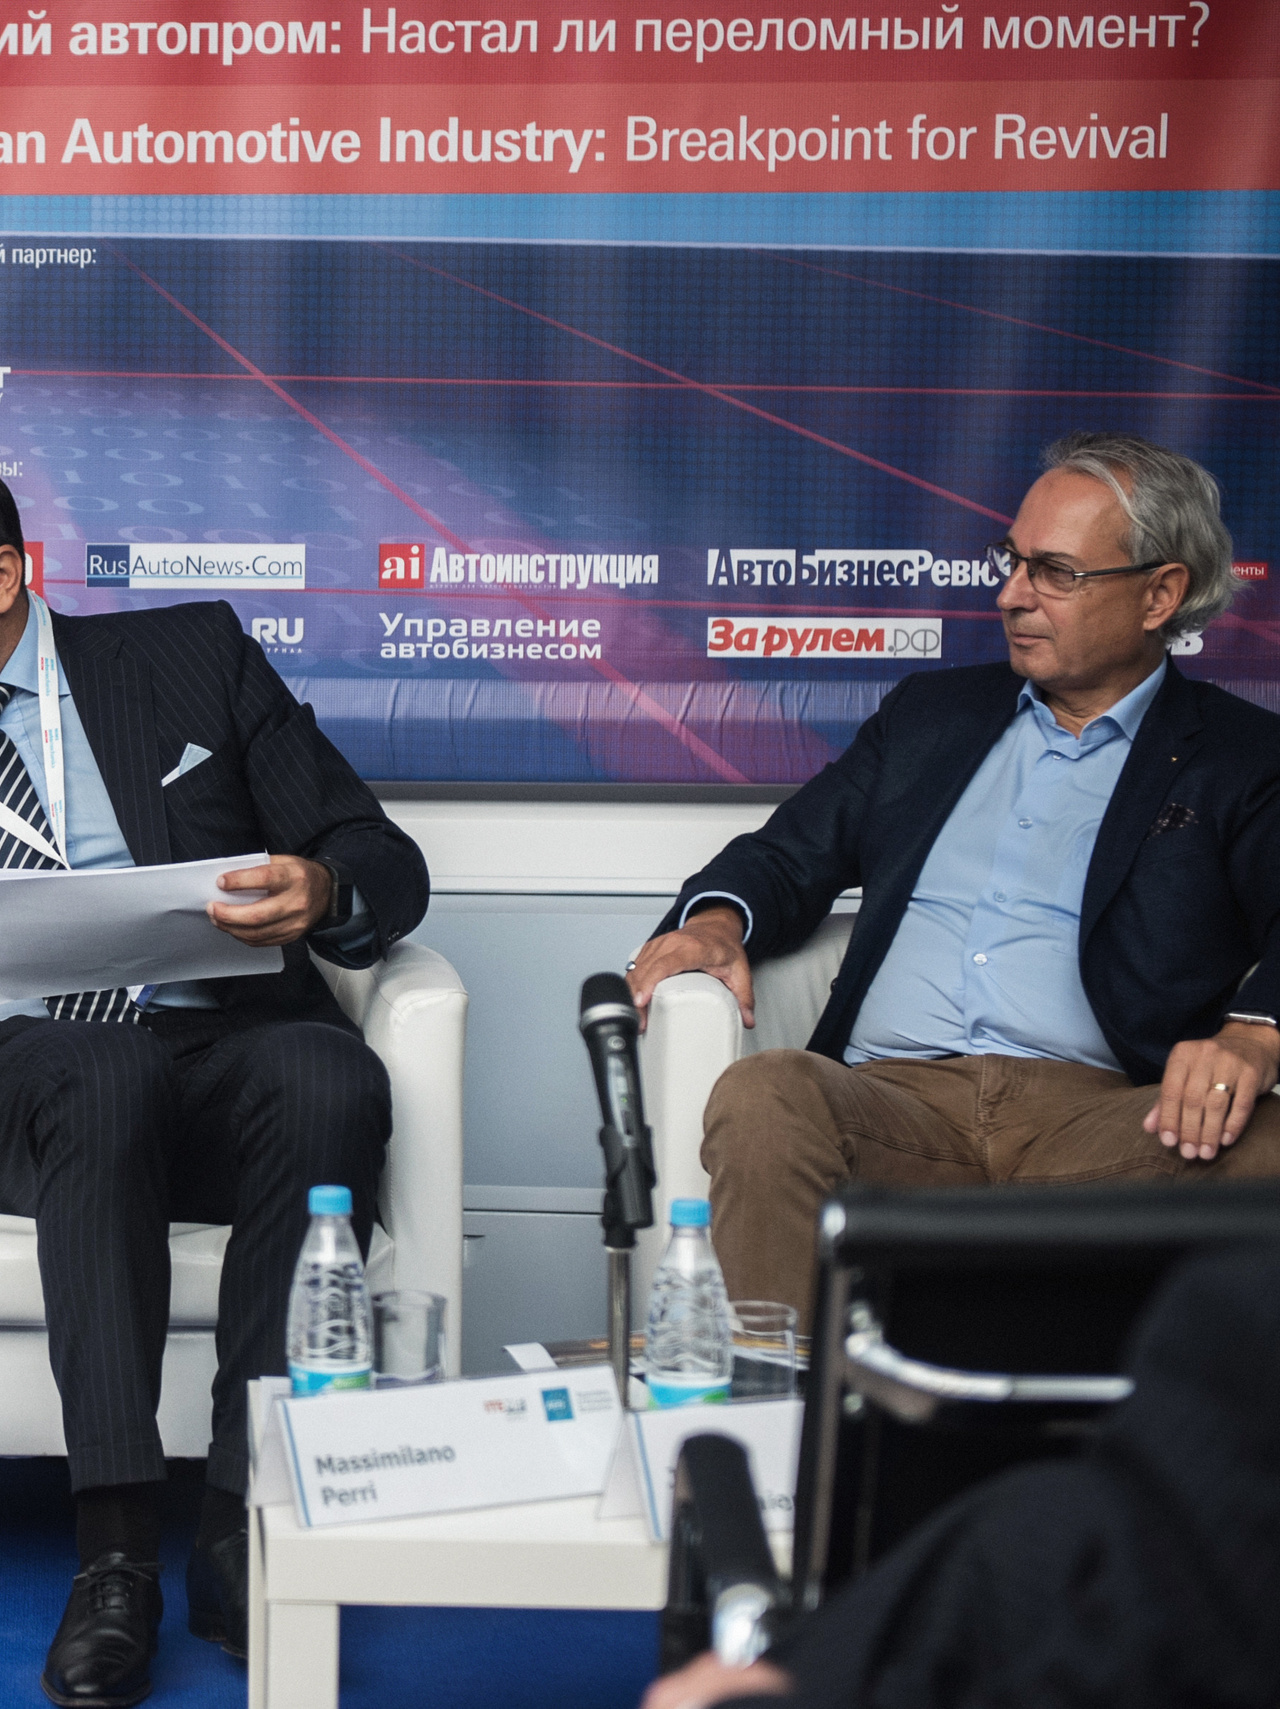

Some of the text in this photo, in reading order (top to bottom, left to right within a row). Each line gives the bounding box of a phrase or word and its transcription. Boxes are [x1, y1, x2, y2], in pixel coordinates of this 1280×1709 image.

[69, 21, 342, 66] автопром:
[362, 8, 539, 54] Настал
[553, 20, 617, 53] ли
[635, 5, 965, 63] переломный
[983, 2, 1210, 50] момент?
[61, 117, 362, 166] Automotive
[379, 116, 607, 175] Industry:
[626, 115, 894, 174] Breakpoint
[907, 114, 978, 161] for
[994, 113, 1169, 160] Revival
[11, 248, 98, 269] партнер:
[429, 546, 660, 590] Автоинструкция
[378, 612, 602, 643] Управление
[380, 637, 602, 660] автобизнесом
[321, 1480, 378, 1507] Perri
